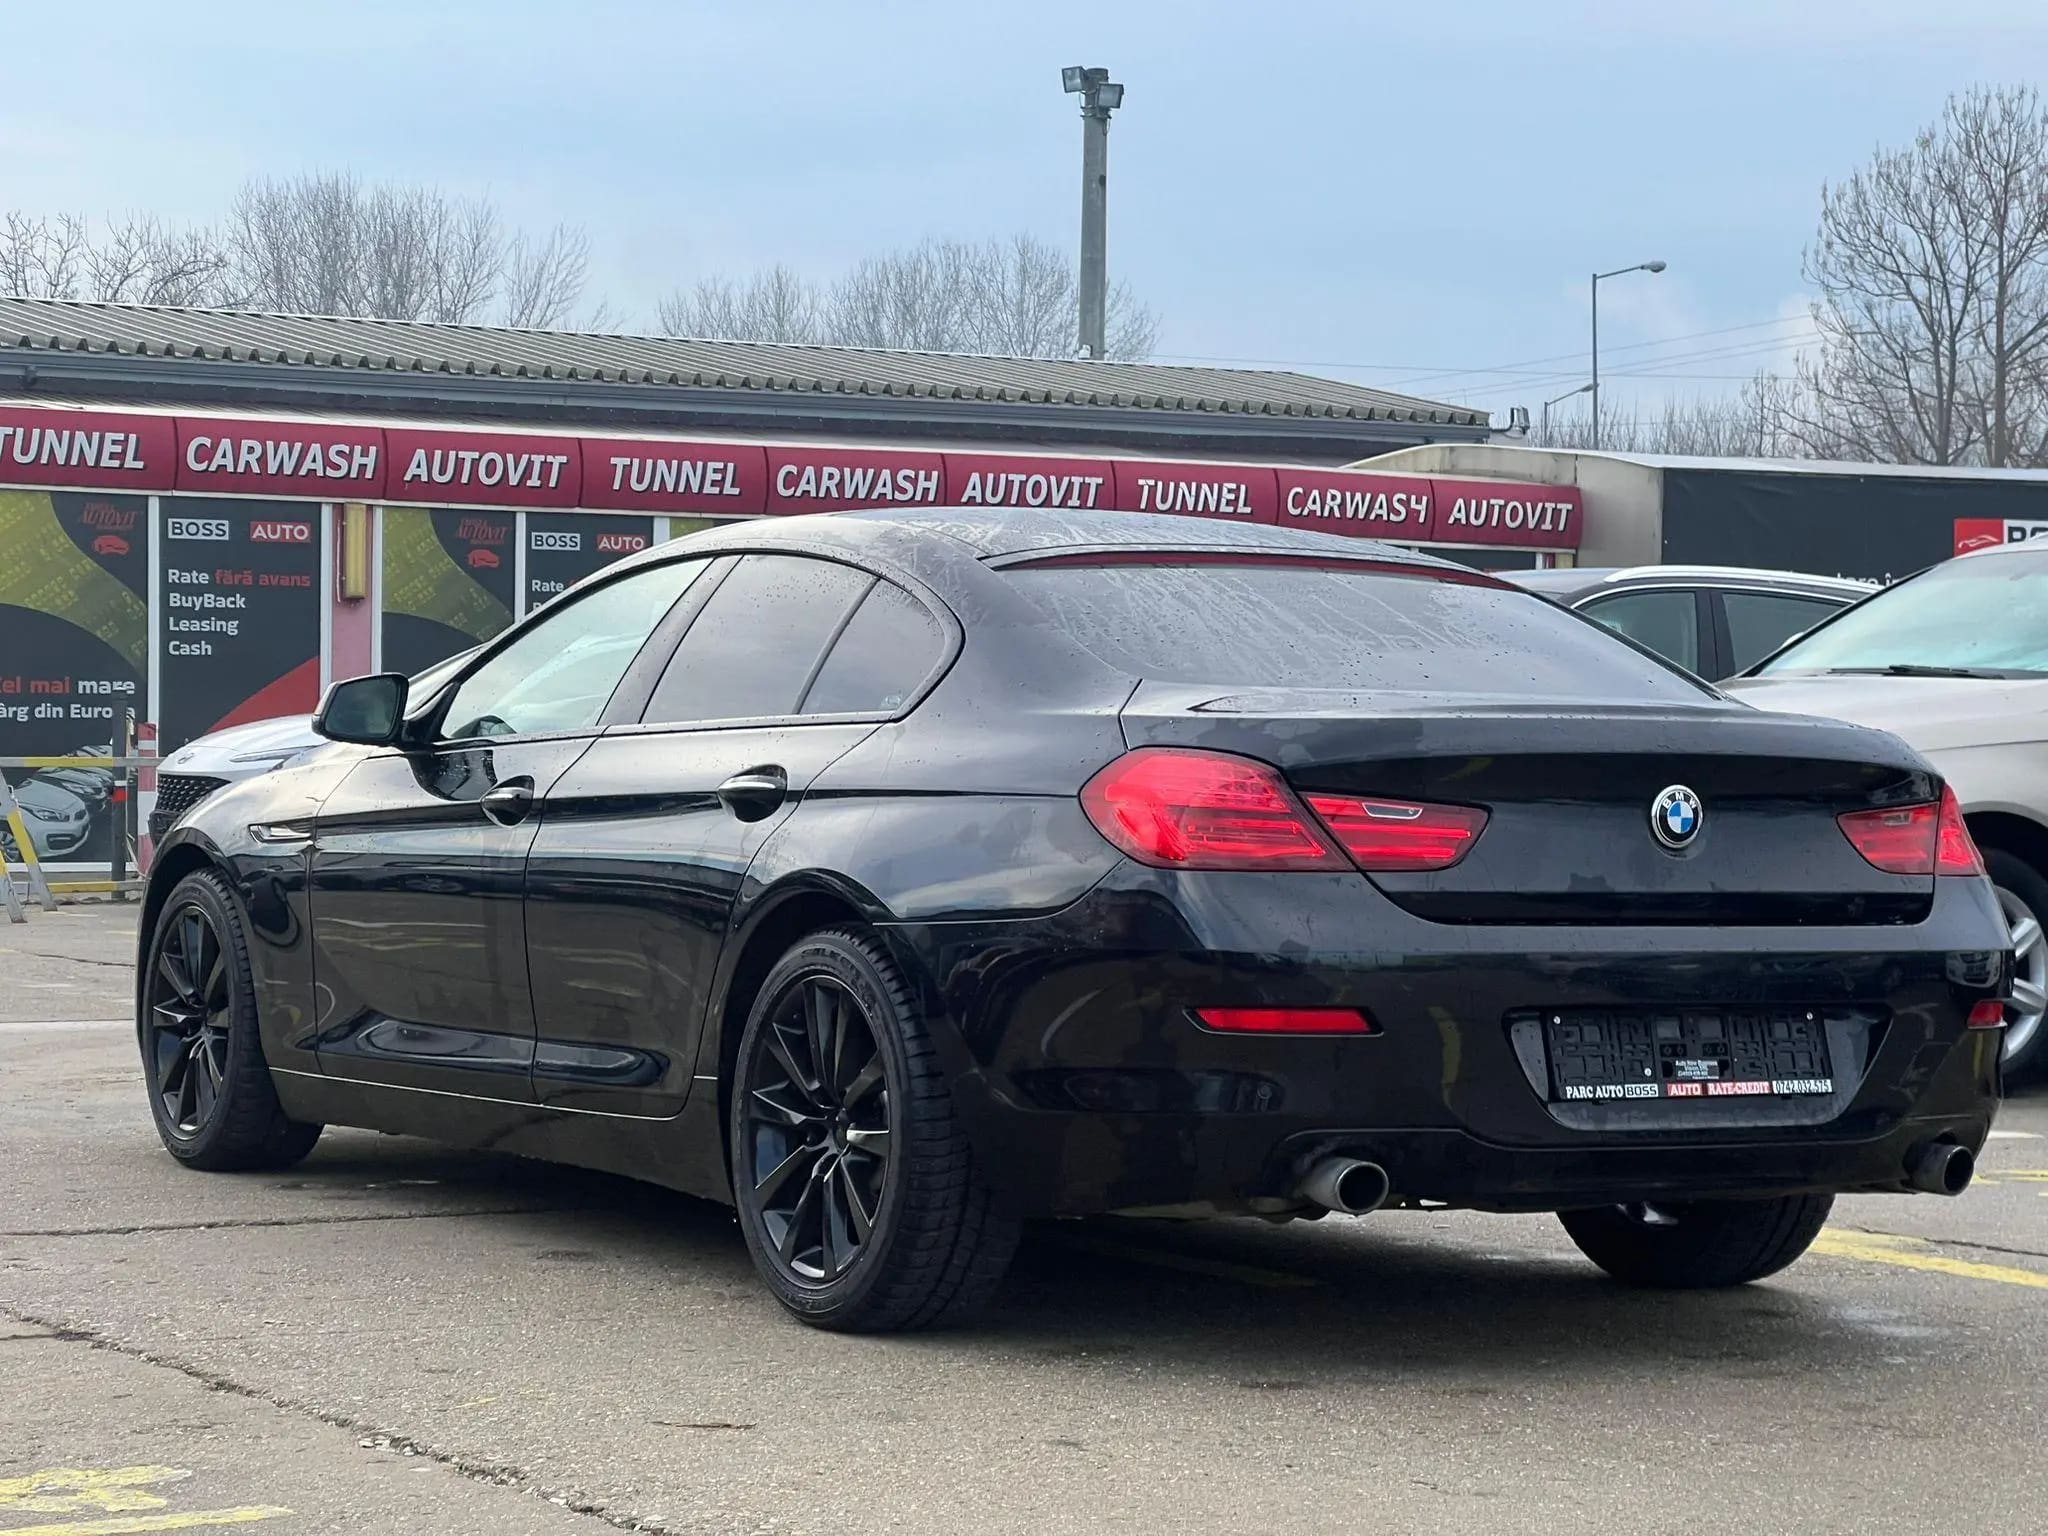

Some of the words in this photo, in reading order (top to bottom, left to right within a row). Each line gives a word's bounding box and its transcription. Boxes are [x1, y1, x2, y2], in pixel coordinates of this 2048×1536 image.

[0, 427, 145, 470] TUNNEL
[186, 436, 377, 479] CARWASH
[404, 448, 568, 488] AUTOVIT
[610, 456, 742, 496] TUNNEL
[776, 464, 939, 502] CARWASH
[961, 472, 1103, 508] AUTOVIT
[1138, 479, 1252, 514] TUNNEL
[1448, 498, 1574, 532] AUTOVIT
[171, 521, 227, 537] BOSS
[252, 524, 309, 540] AUTO
[534, 534, 578, 548] BOSS
[598, 536, 645, 550] AUTO
[168, 569, 209, 584] Rate
[259, 574, 311, 587] avans
[531, 580, 565, 592] Rate
[169, 593, 246, 610] BuyBack
[168, 617, 239, 635] Leasing
[168, 641, 212, 655] Cash
[0, 676, 21, 693] el
[30, 676, 70, 694] mai
[78, 680, 135, 694] mare
[0, 703, 29, 721] ârg
[34, 703, 63, 718] din
[70, 704, 136, 719] Euroa
[1662, 791, 1697, 809] BMW
[1565, 1085, 1593, 1099] PARC
[1595, 1085, 1624, 1098] AUTO
[1626, 1085, 1657, 1097] BOSS
[1669, 1083, 1701, 1096] AUTO
